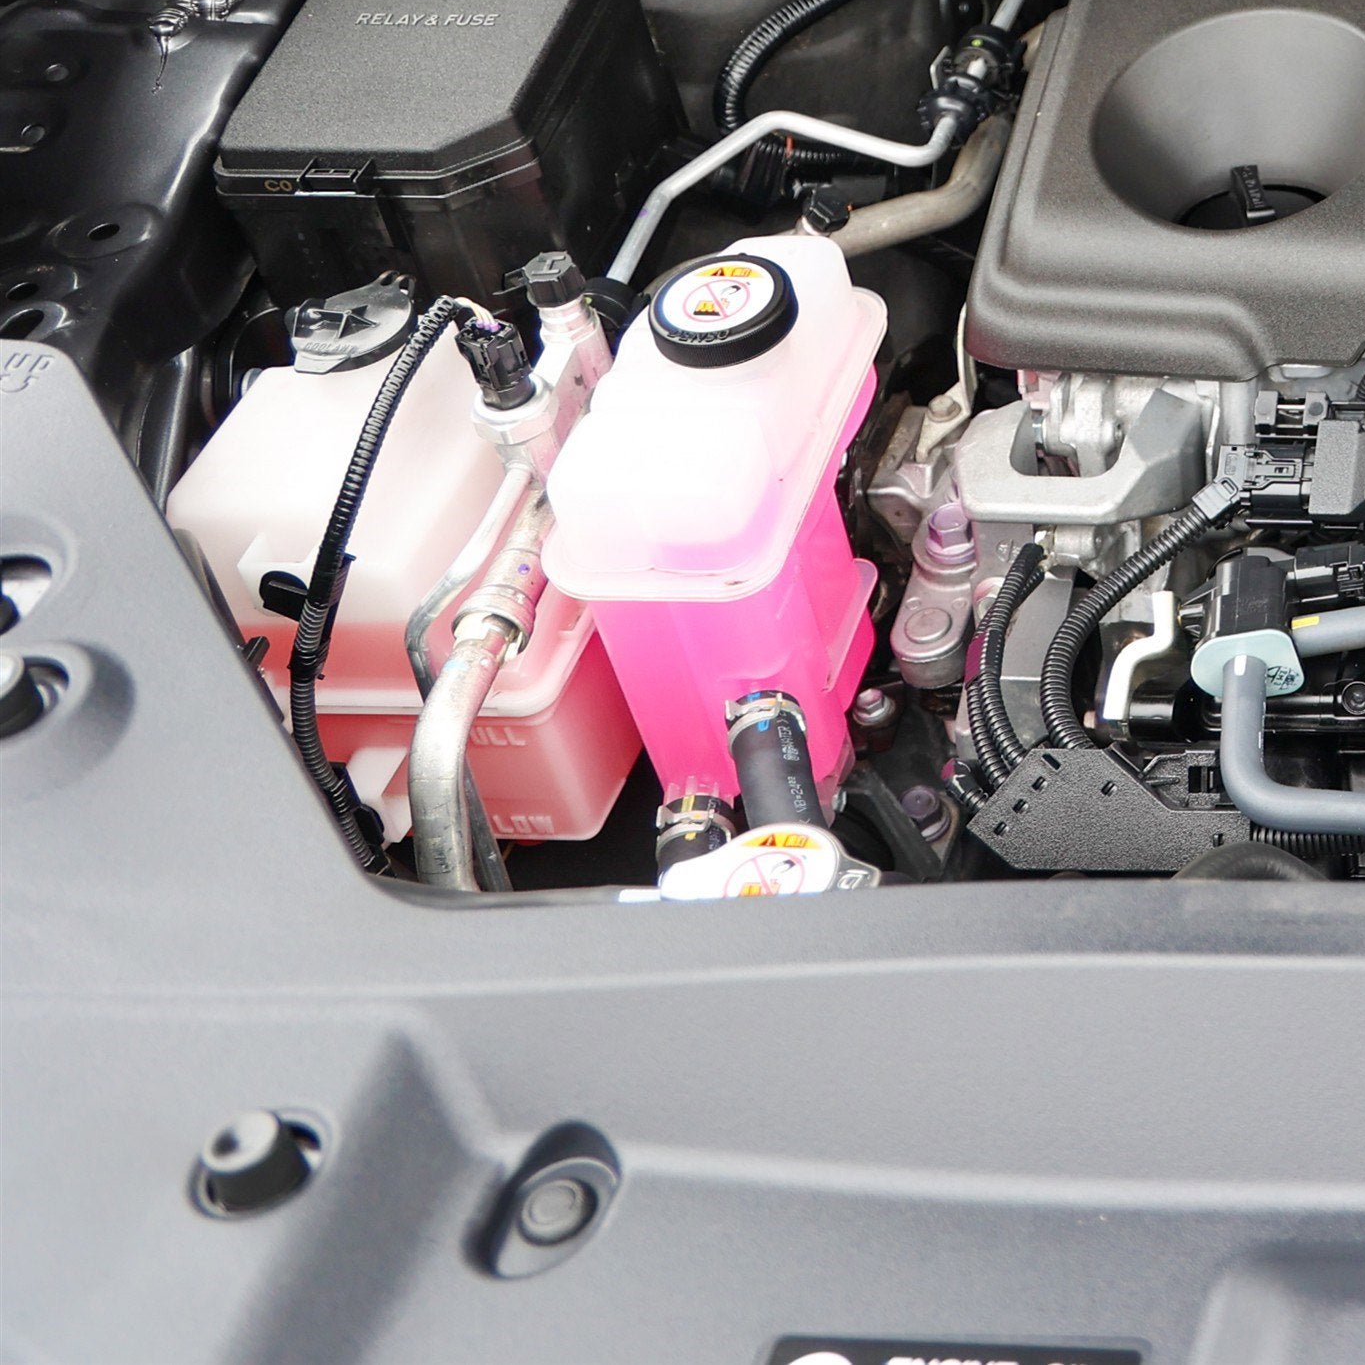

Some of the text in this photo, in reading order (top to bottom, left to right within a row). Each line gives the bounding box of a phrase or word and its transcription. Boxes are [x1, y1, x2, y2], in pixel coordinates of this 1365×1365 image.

[355, 13, 500, 26] RELAY & FUSE
[4, 352, 56, 373] UP
[469, 726, 526, 746] ULL
[492, 815, 554, 834] LOW
